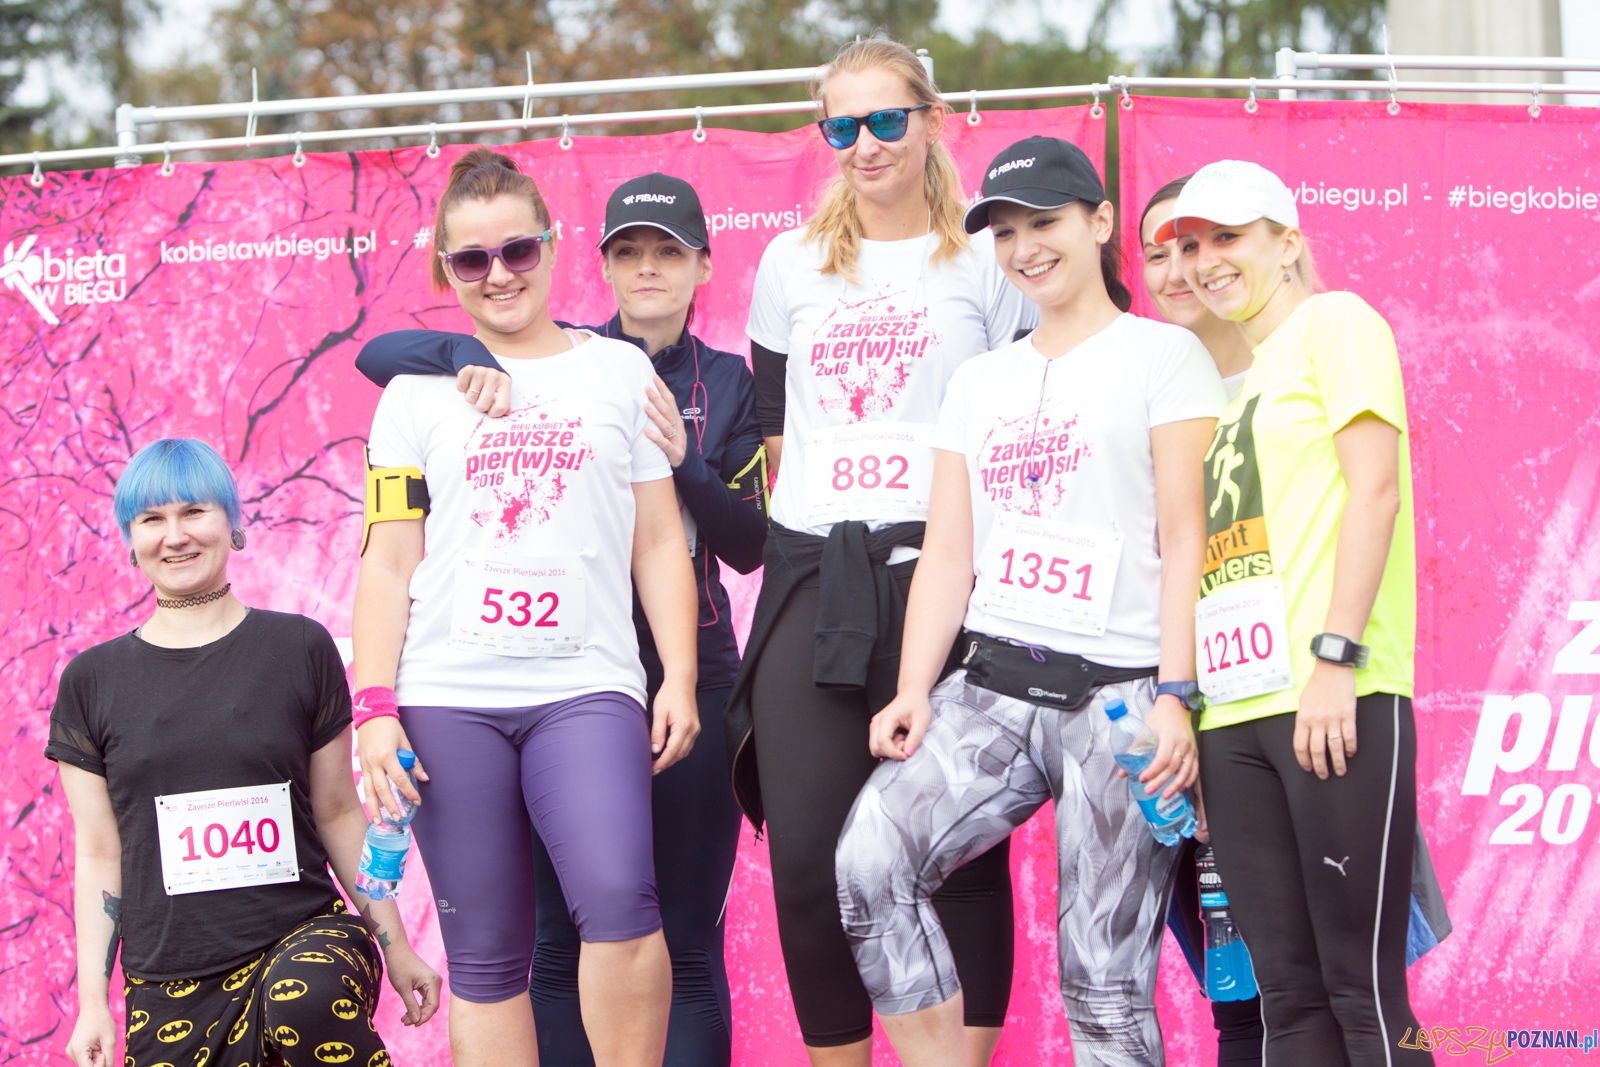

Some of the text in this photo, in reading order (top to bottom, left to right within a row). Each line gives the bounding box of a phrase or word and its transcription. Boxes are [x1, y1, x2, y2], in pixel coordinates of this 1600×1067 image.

[997, 158, 1034, 176] FIBARO
[635, 194, 672, 205] FIBARO
[1448, 185, 1600, 214] #biegkobie
[161, 230, 376, 264] kobietawbiegu.pl
[35, 279, 126, 307] W BIEGU
[826, 321, 918, 339] zawsze
[478, 430, 574, 450] zawsze
[511, 422, 564, 431] BIEG KOBIET
[895, 432, 915, 442] 2016
[989, 432, 1070, 463] zawsze
[473, 471, 505, 491] 2016
[831, 454, 909, 492] 882
[484, 563, 567, 578] Zawsze Pier(w)si 2016
[999, 548, 1093, 602] 1351
[480, 587, 560, 628] 532
[1203, 621, 1274, 674] 1210
[187, 802, 216, 812] Zawsze
[217, 799, 250, 808] Pier(w)si
[250, 796, 269, 805] 2016
[1488, 783, 1600, 845] 20
[178, 817, 280, 862] 1040
